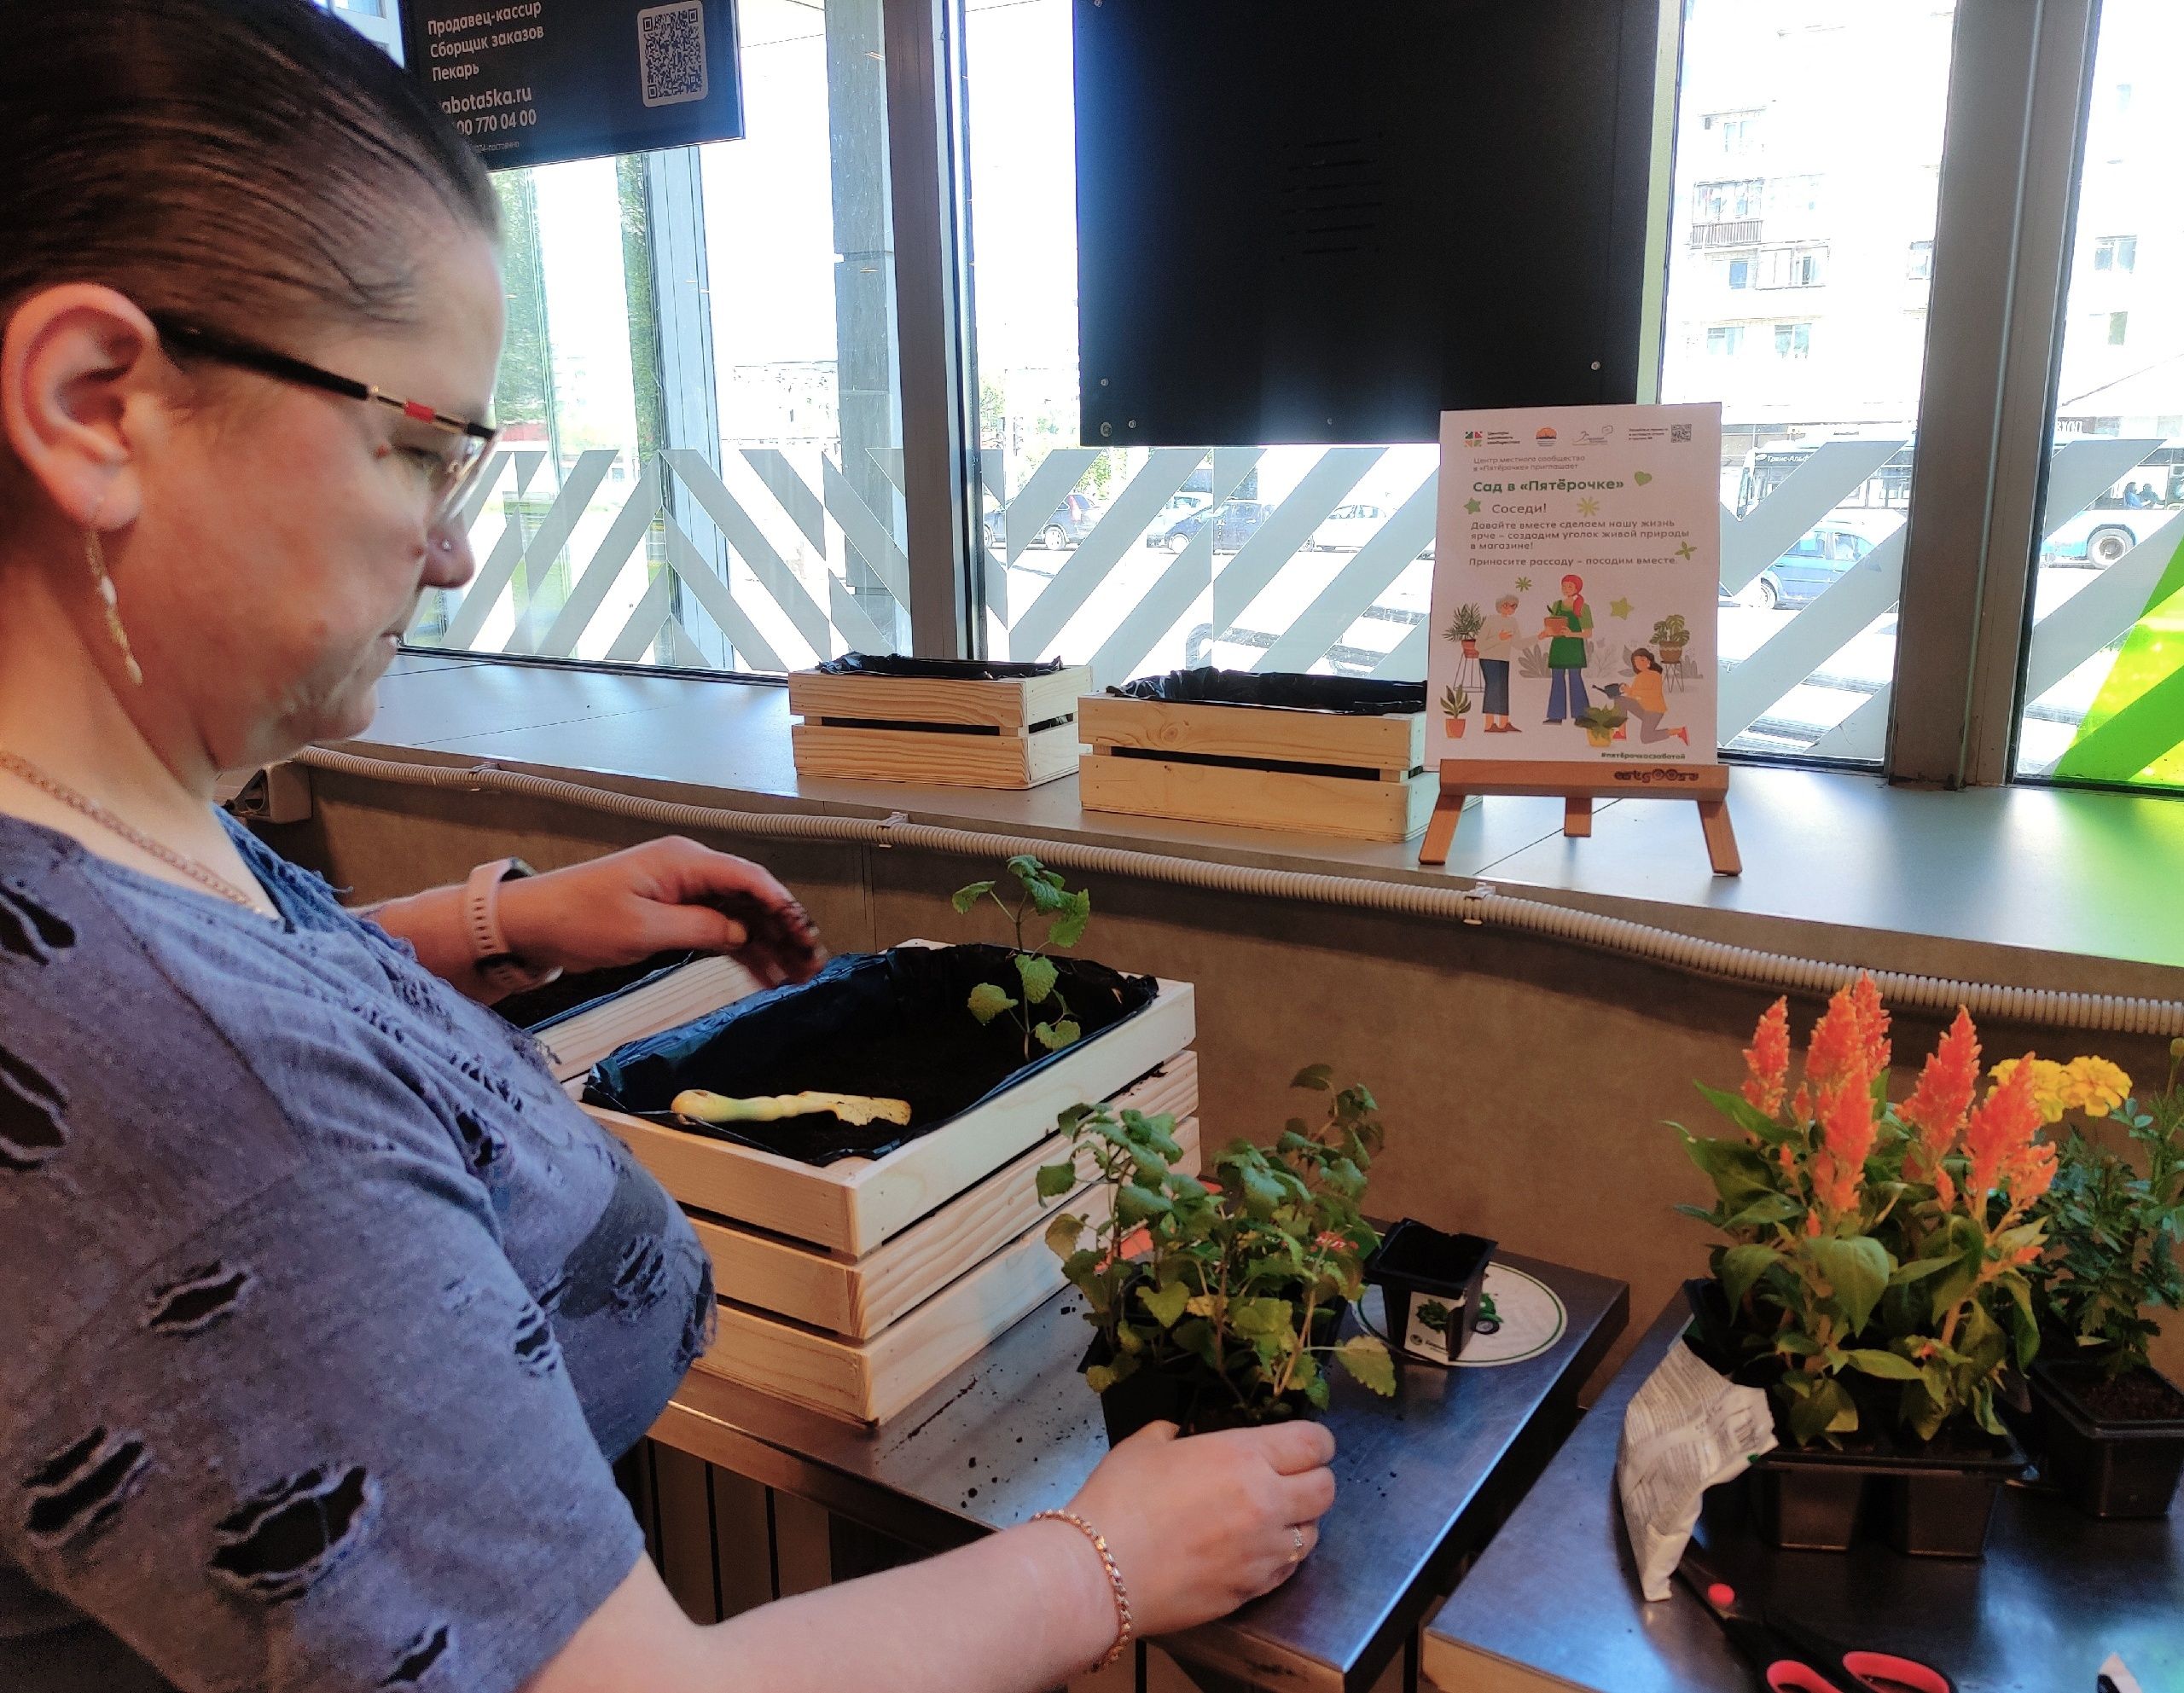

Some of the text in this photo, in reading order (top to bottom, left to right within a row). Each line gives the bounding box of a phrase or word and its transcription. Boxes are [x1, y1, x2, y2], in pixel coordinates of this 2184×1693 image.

[427, 1, 543, 38] Продавец-кассир
[430, 26, 544, 59] Сборщик заказов
[433, 63, 479, 82] Пекарь
[440, 87, 533, 115] abota5ka.ru
[475, 114, 497, 134] 770
[500, 111, 516, 130] 04
[520, 108, 537, 127] 00
[1472, 478, 1624, 494] Сад в «Пятёрочке»
[1491, 503, 1547, 515] Соседи!
[1471, 522, 1517, 531] Давайте
[1560, 520, 1606, 529] сделаем
[1609, 520, 1638, 529] нашу
[1562, 531, 1599, 540] уголок
[1601, 530, 1637, 538] живой
[1640, 531, 1690, 539] природы
[1479, 542, 1534, 550] магазине!
[1469, 558, 1527, 566] Приносите
